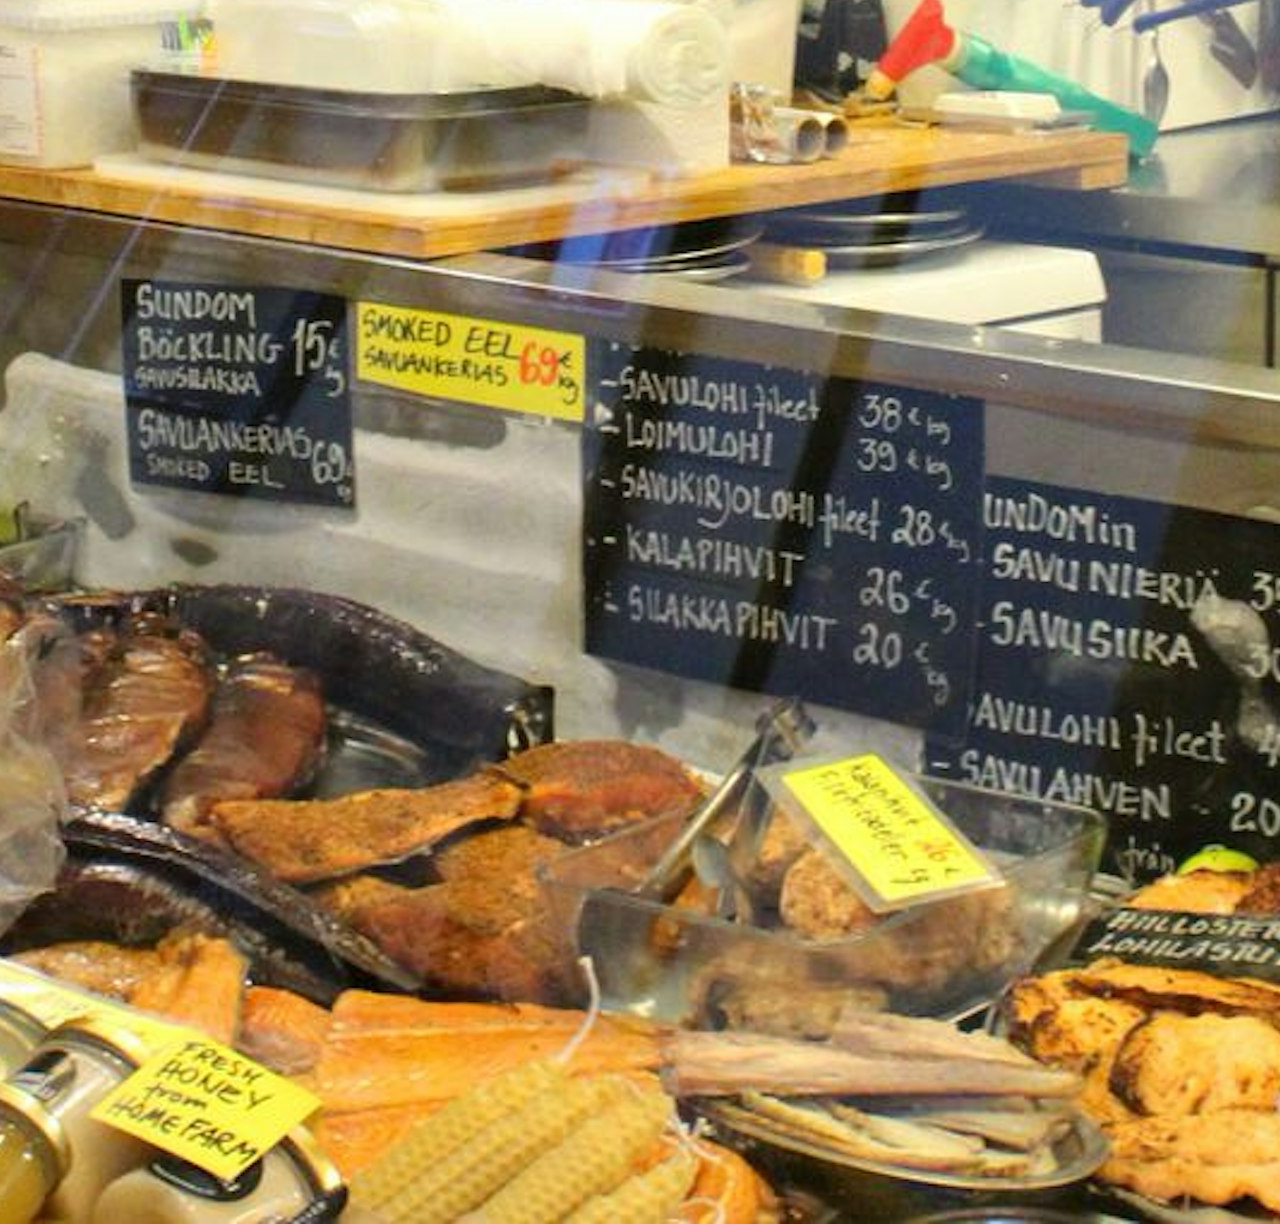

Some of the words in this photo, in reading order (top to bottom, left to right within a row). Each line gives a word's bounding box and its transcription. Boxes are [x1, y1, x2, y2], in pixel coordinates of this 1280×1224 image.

[135, 282, 257, 328] SUNDOM
[362, 308, 452, 347] SMOKED
[463, 326, 521, 361] EEL
[619, 365, 750, 416] SAVULOHI
[857, 394, 903, 430] 38
[625, 414, 775, 467] LOIMULOHI
[856, 437, 898, 473] 39
[228, 460, 286, 490] EEL
[890, 504, 937, 548] 28
[981, 490, 1137, 553] UNDOMin
[625, 526, 808, 588] KALAPIHVIT
[858, 567, 911, 616] 26
[852, 622, 903, 669] 20
[973, 692, 1121, 750] AVULOHI
[157, 1059, 272, 1112] HONEY
[176, 1040, 264, 1084] FRESH
